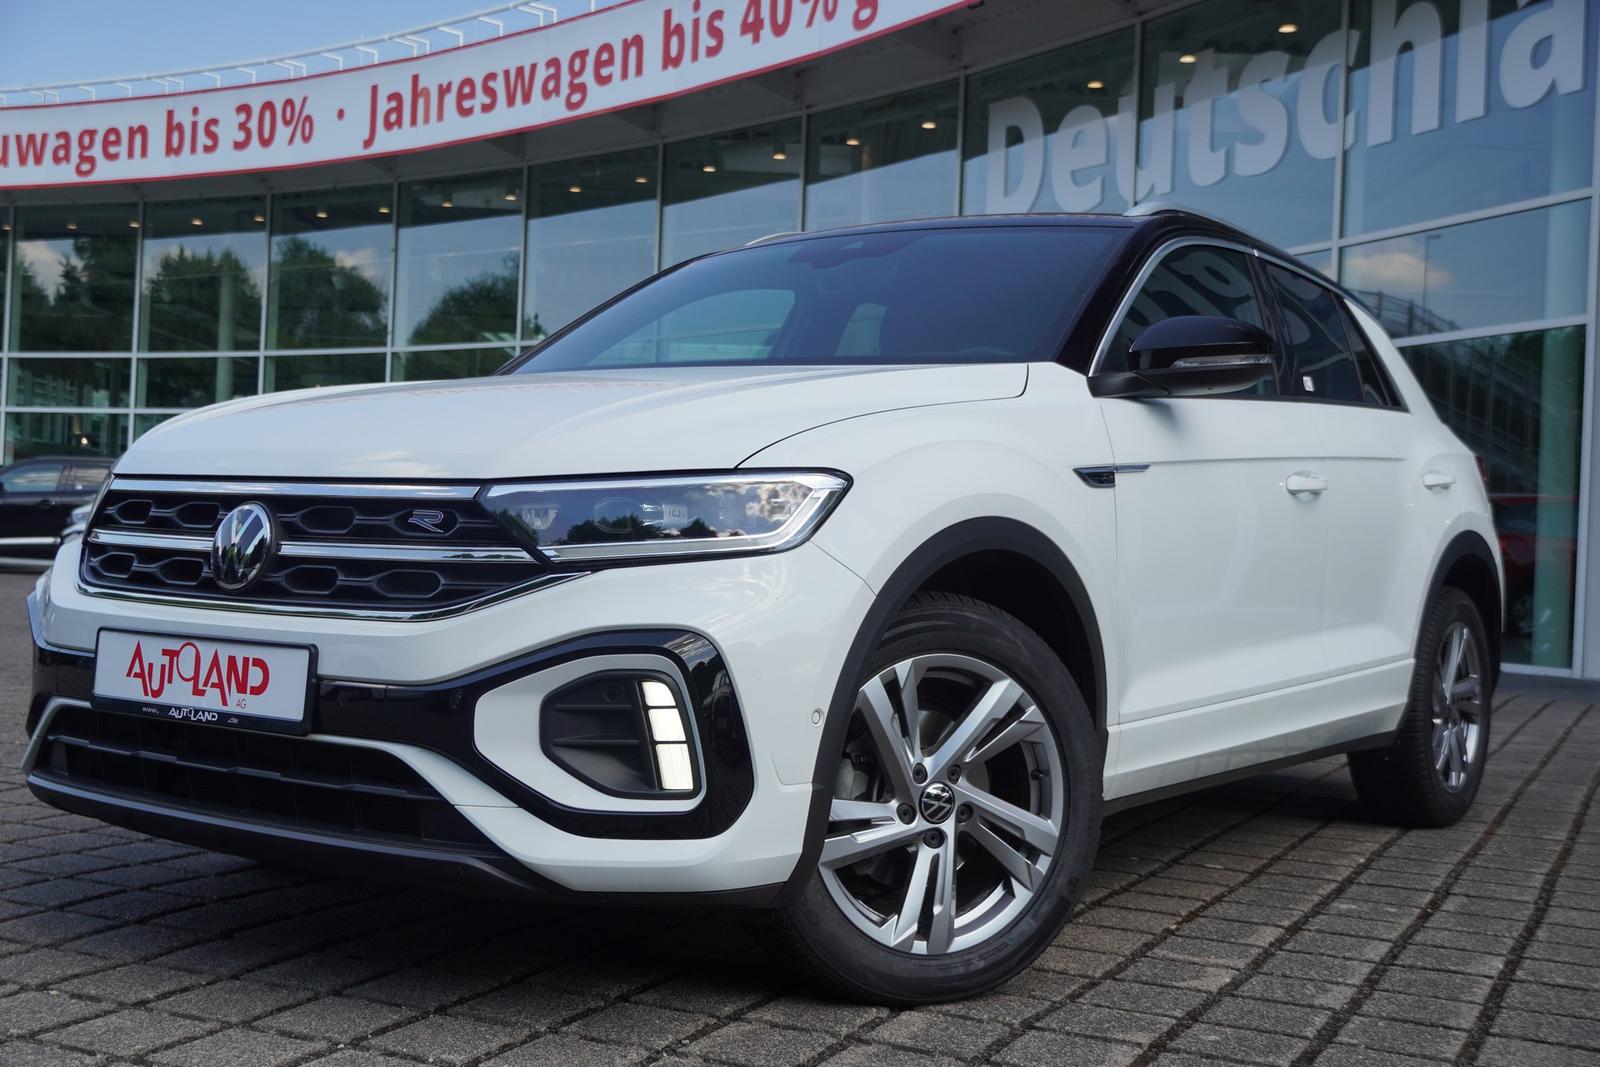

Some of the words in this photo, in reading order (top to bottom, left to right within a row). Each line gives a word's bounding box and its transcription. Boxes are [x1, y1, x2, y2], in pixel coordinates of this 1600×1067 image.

[164, 106, 219, 157] bis
[232, 96, 314, 151] 30%
[362, 33, 645, 150] Jahreswagen
[661, 0, 724, 70] bis
[235, 698, 247, 709] AG
